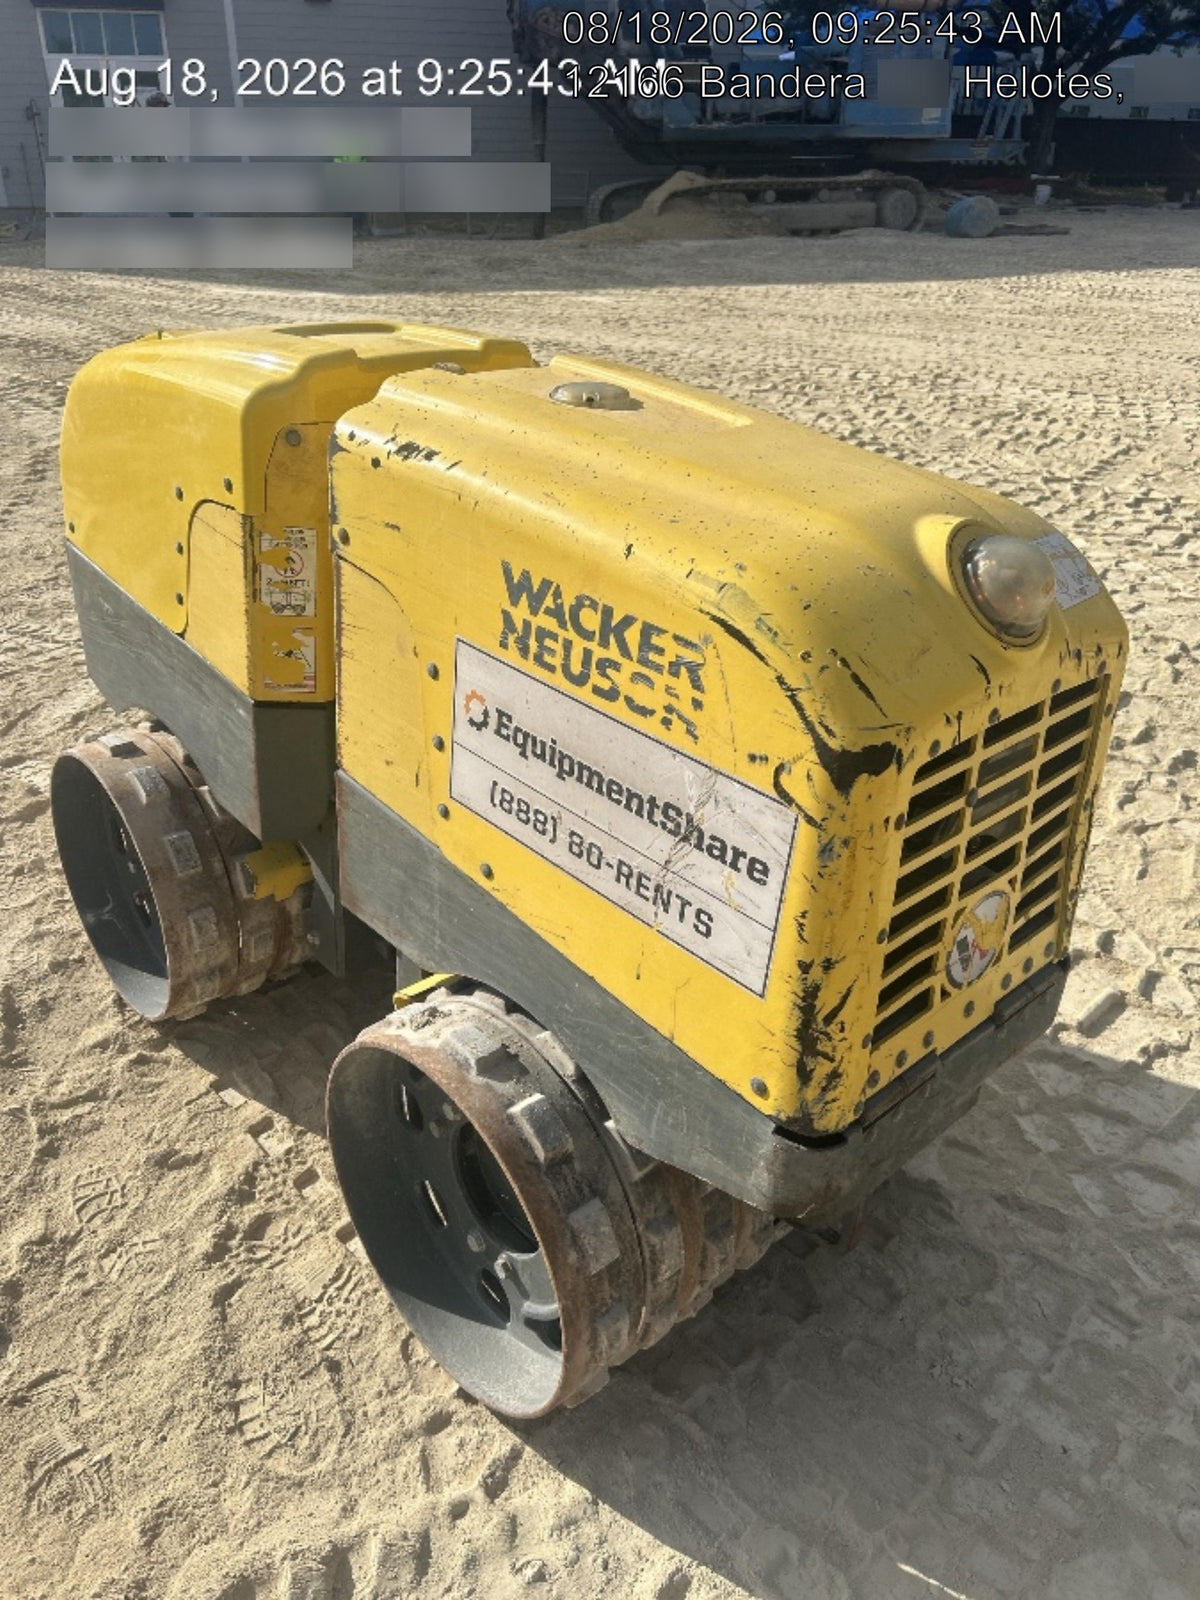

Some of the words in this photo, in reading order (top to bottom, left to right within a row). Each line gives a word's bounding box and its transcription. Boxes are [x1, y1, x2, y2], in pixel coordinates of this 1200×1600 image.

[501, 560, 705, 695] WACKER
[489, 779, 561, 846] (888)
[567, 825, 715, 941] 80-RENTS
[493, 706, 770, 887] EquipmentShare
